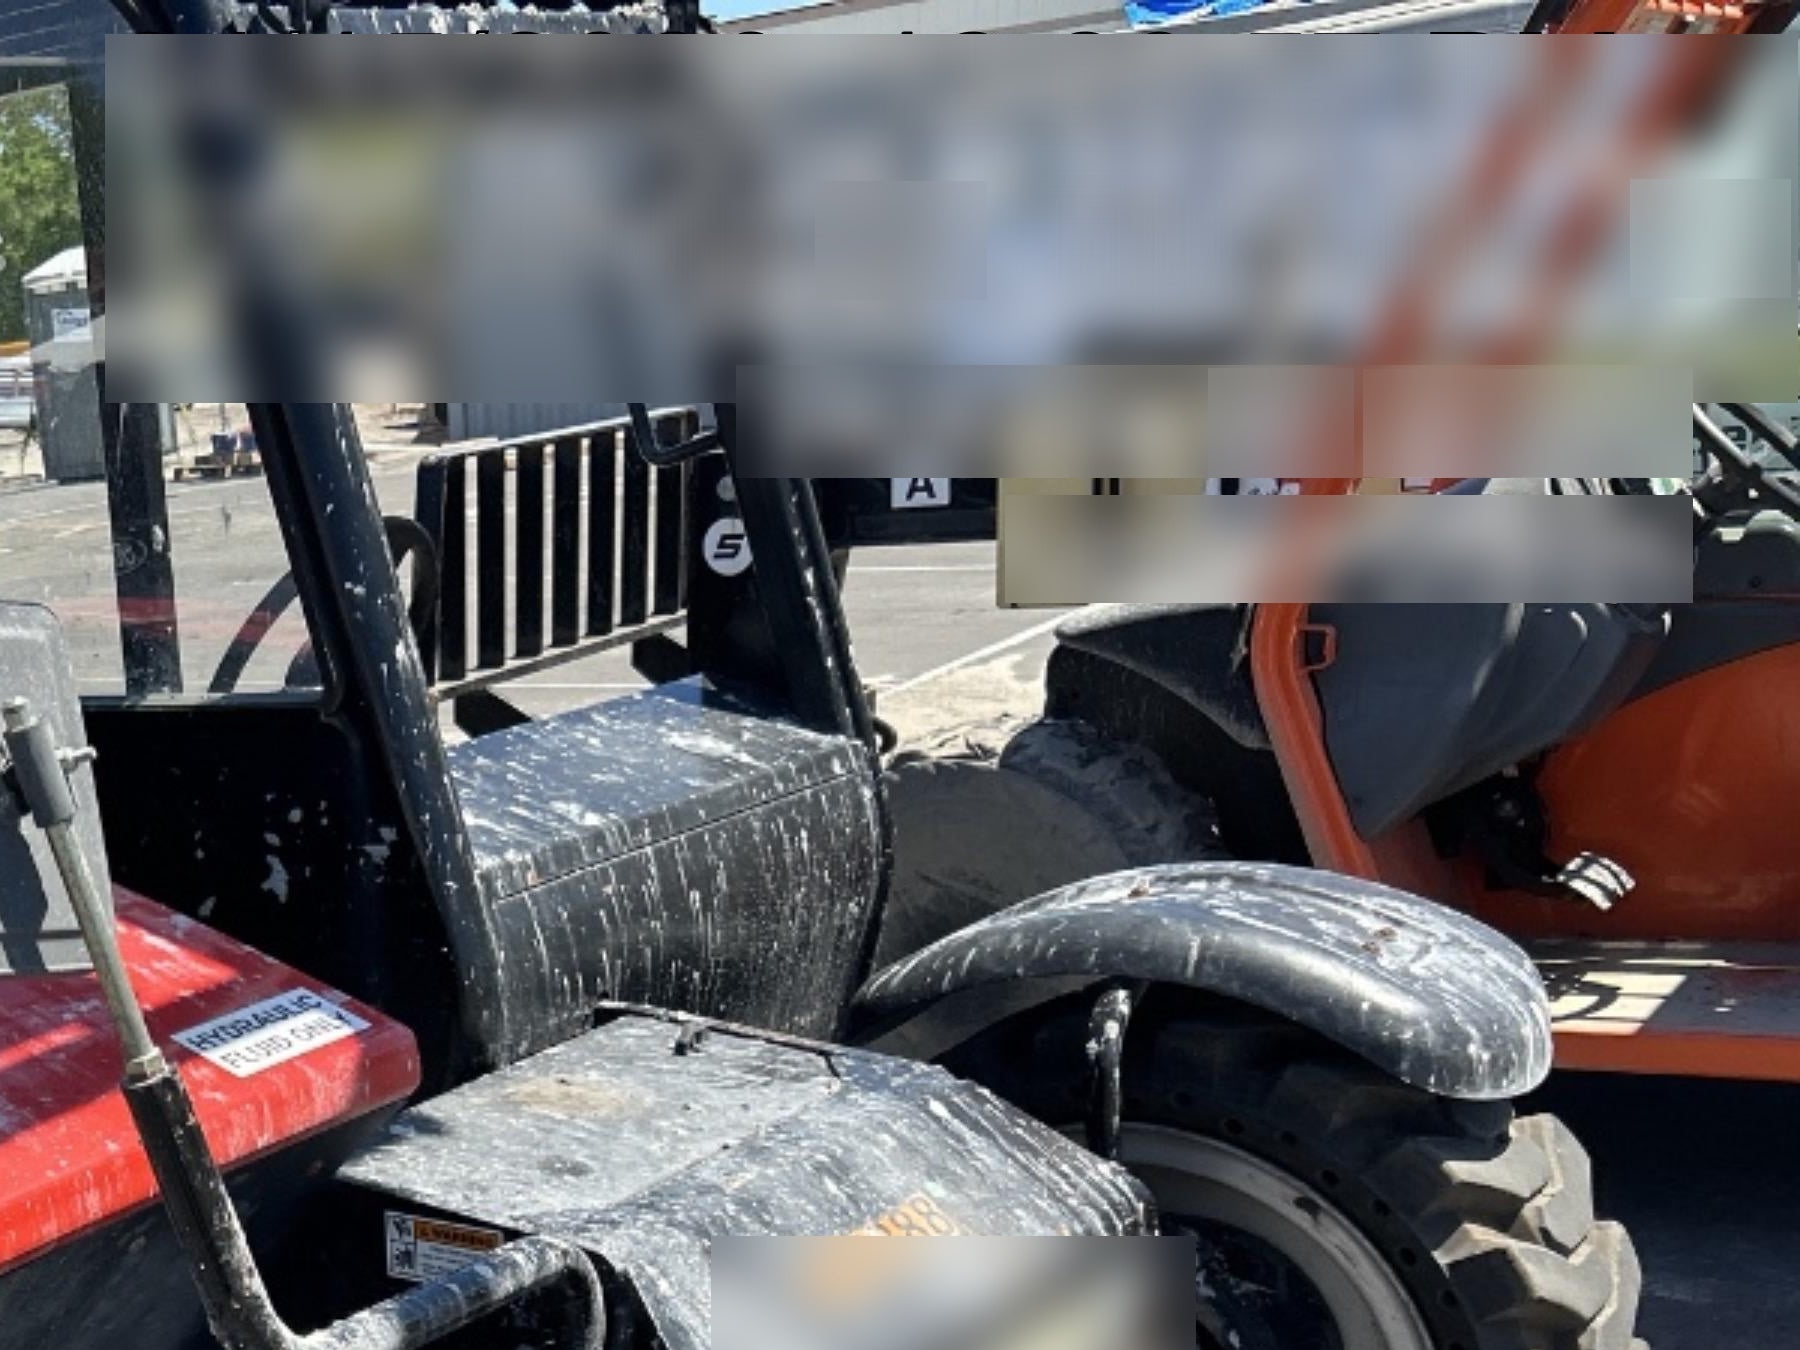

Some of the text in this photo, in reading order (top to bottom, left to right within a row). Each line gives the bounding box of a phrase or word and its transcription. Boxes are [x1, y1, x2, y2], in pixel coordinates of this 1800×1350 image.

[185, 994, 323, 1050] HYDRAULIC
[219, 1010, 351, 1069] FLUID ONLY
